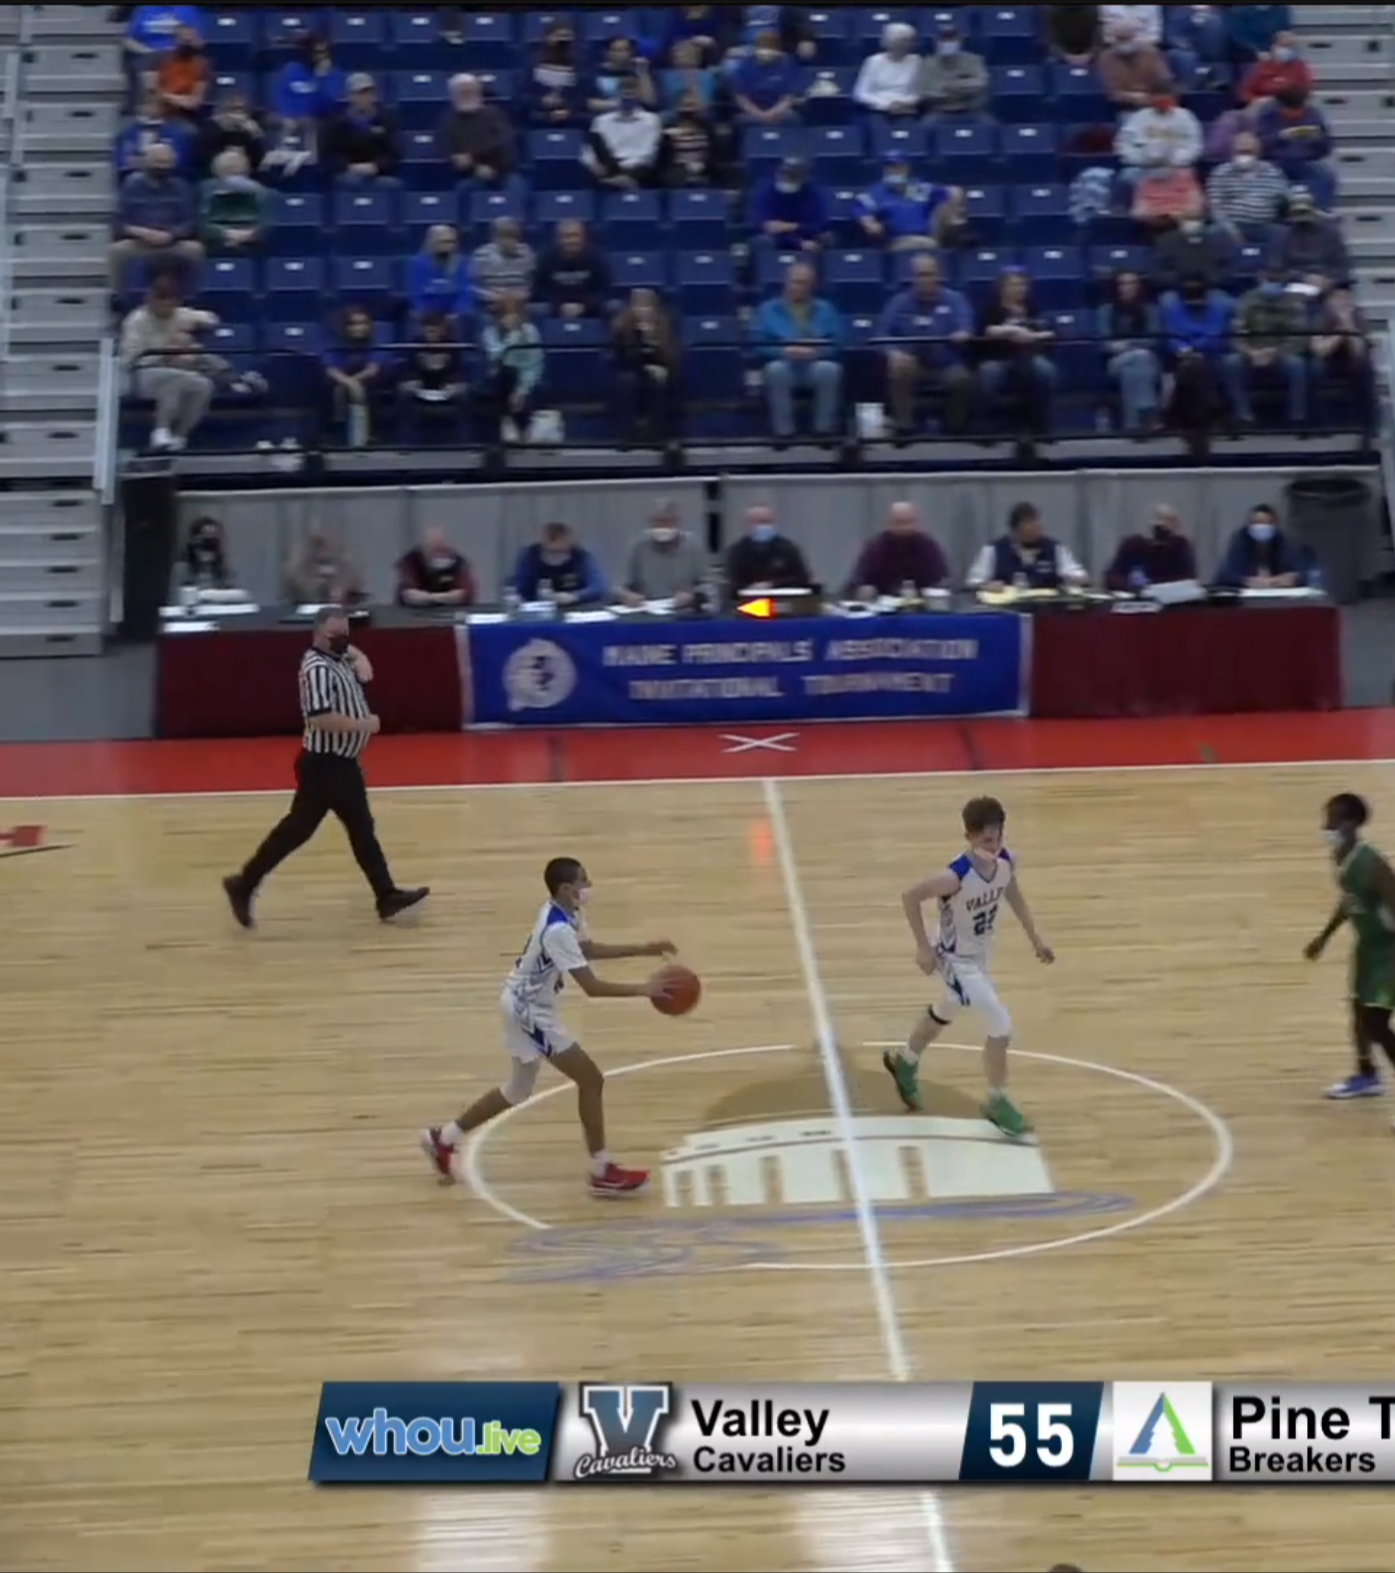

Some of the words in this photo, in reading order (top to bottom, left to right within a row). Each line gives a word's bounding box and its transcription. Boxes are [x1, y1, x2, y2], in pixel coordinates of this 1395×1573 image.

[602, 643, 677, 667] MAINE
[823, 636, 978, 662] ASSOCIATION
[628, 675, 785, 700] INVITATIONAL
[801, 671, 955, 696] TOURNAMENT
